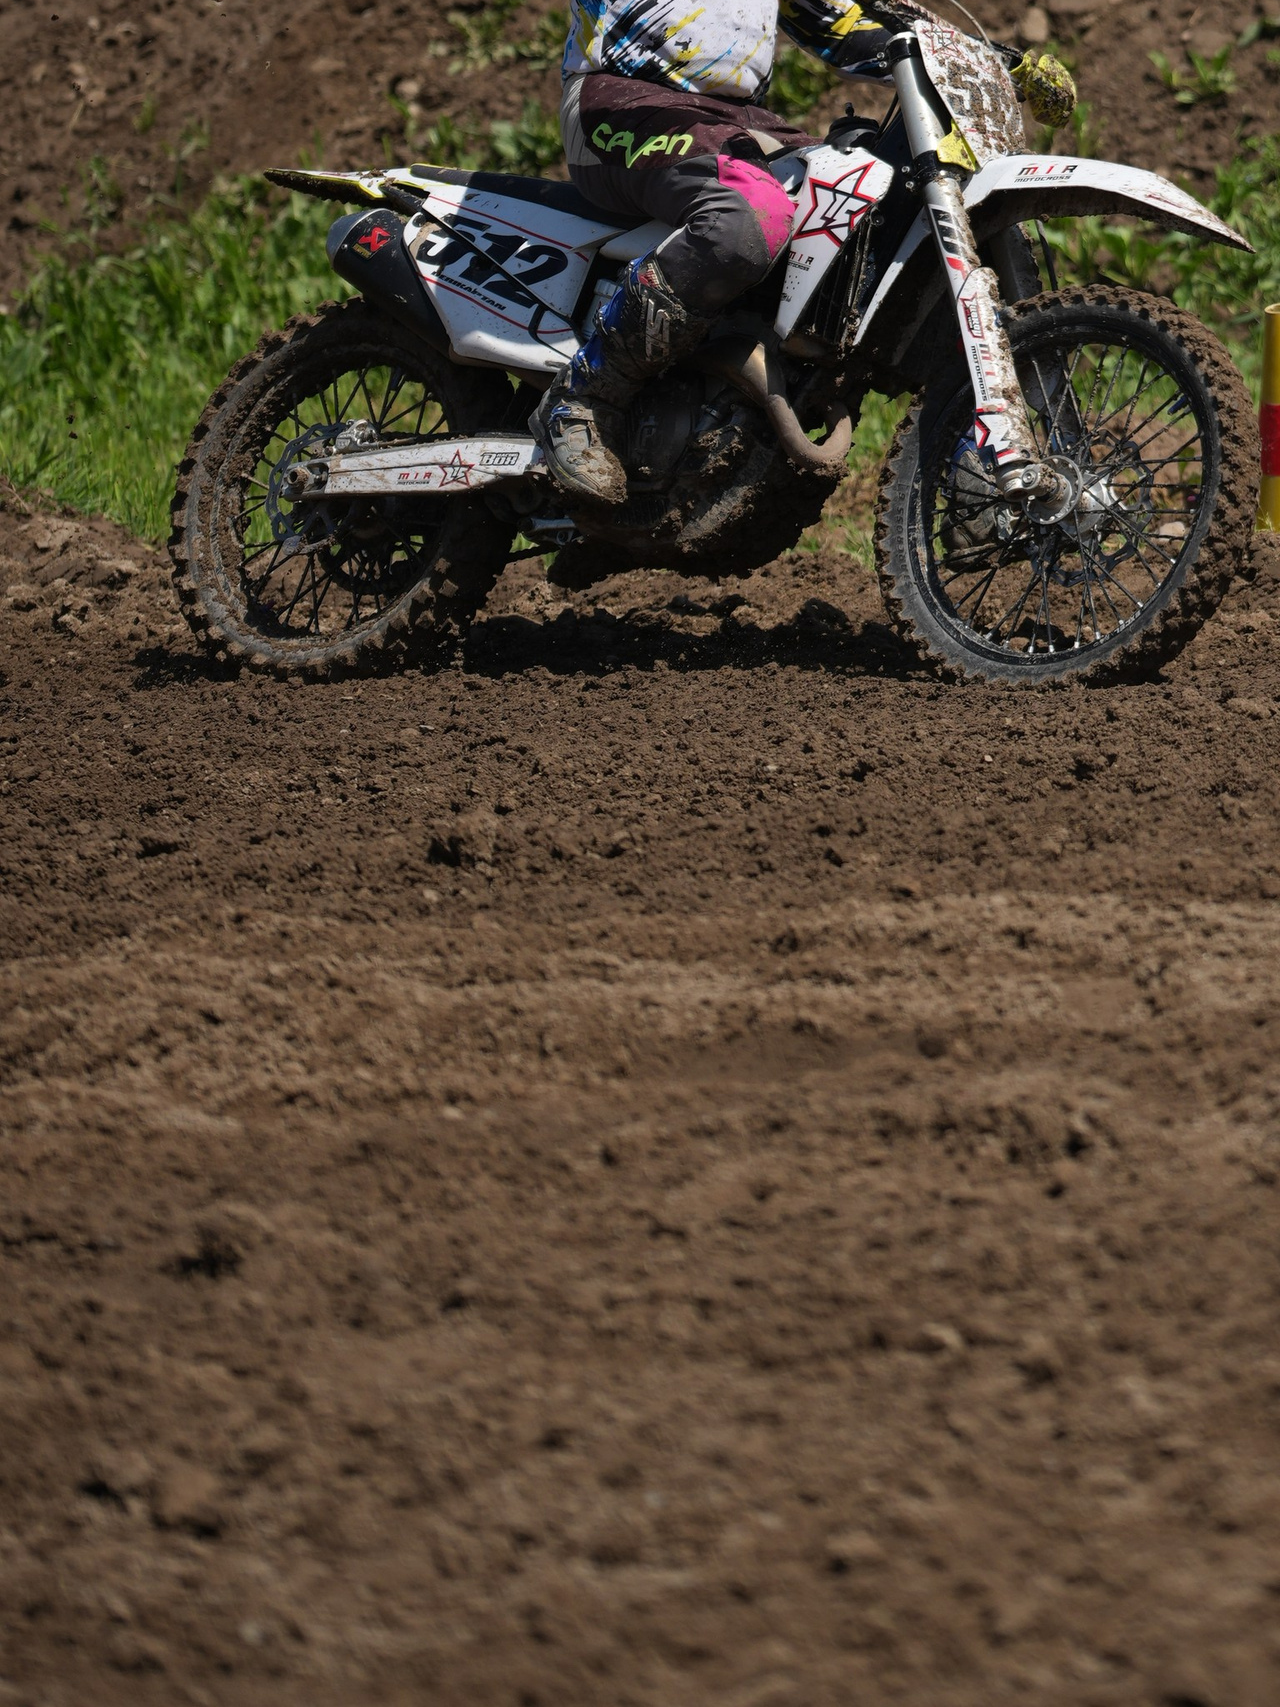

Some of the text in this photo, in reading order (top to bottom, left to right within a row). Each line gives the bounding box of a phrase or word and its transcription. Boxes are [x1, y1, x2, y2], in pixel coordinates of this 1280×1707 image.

[1018, 165, 1078, 176] MIR
[1014, 175, 1071, 183] MOTOCROSS
[416, 213, 569, 309] 512
[970, 345, 989, 402] MOTOCROSS
[397, 472, 432, 480] MIR
